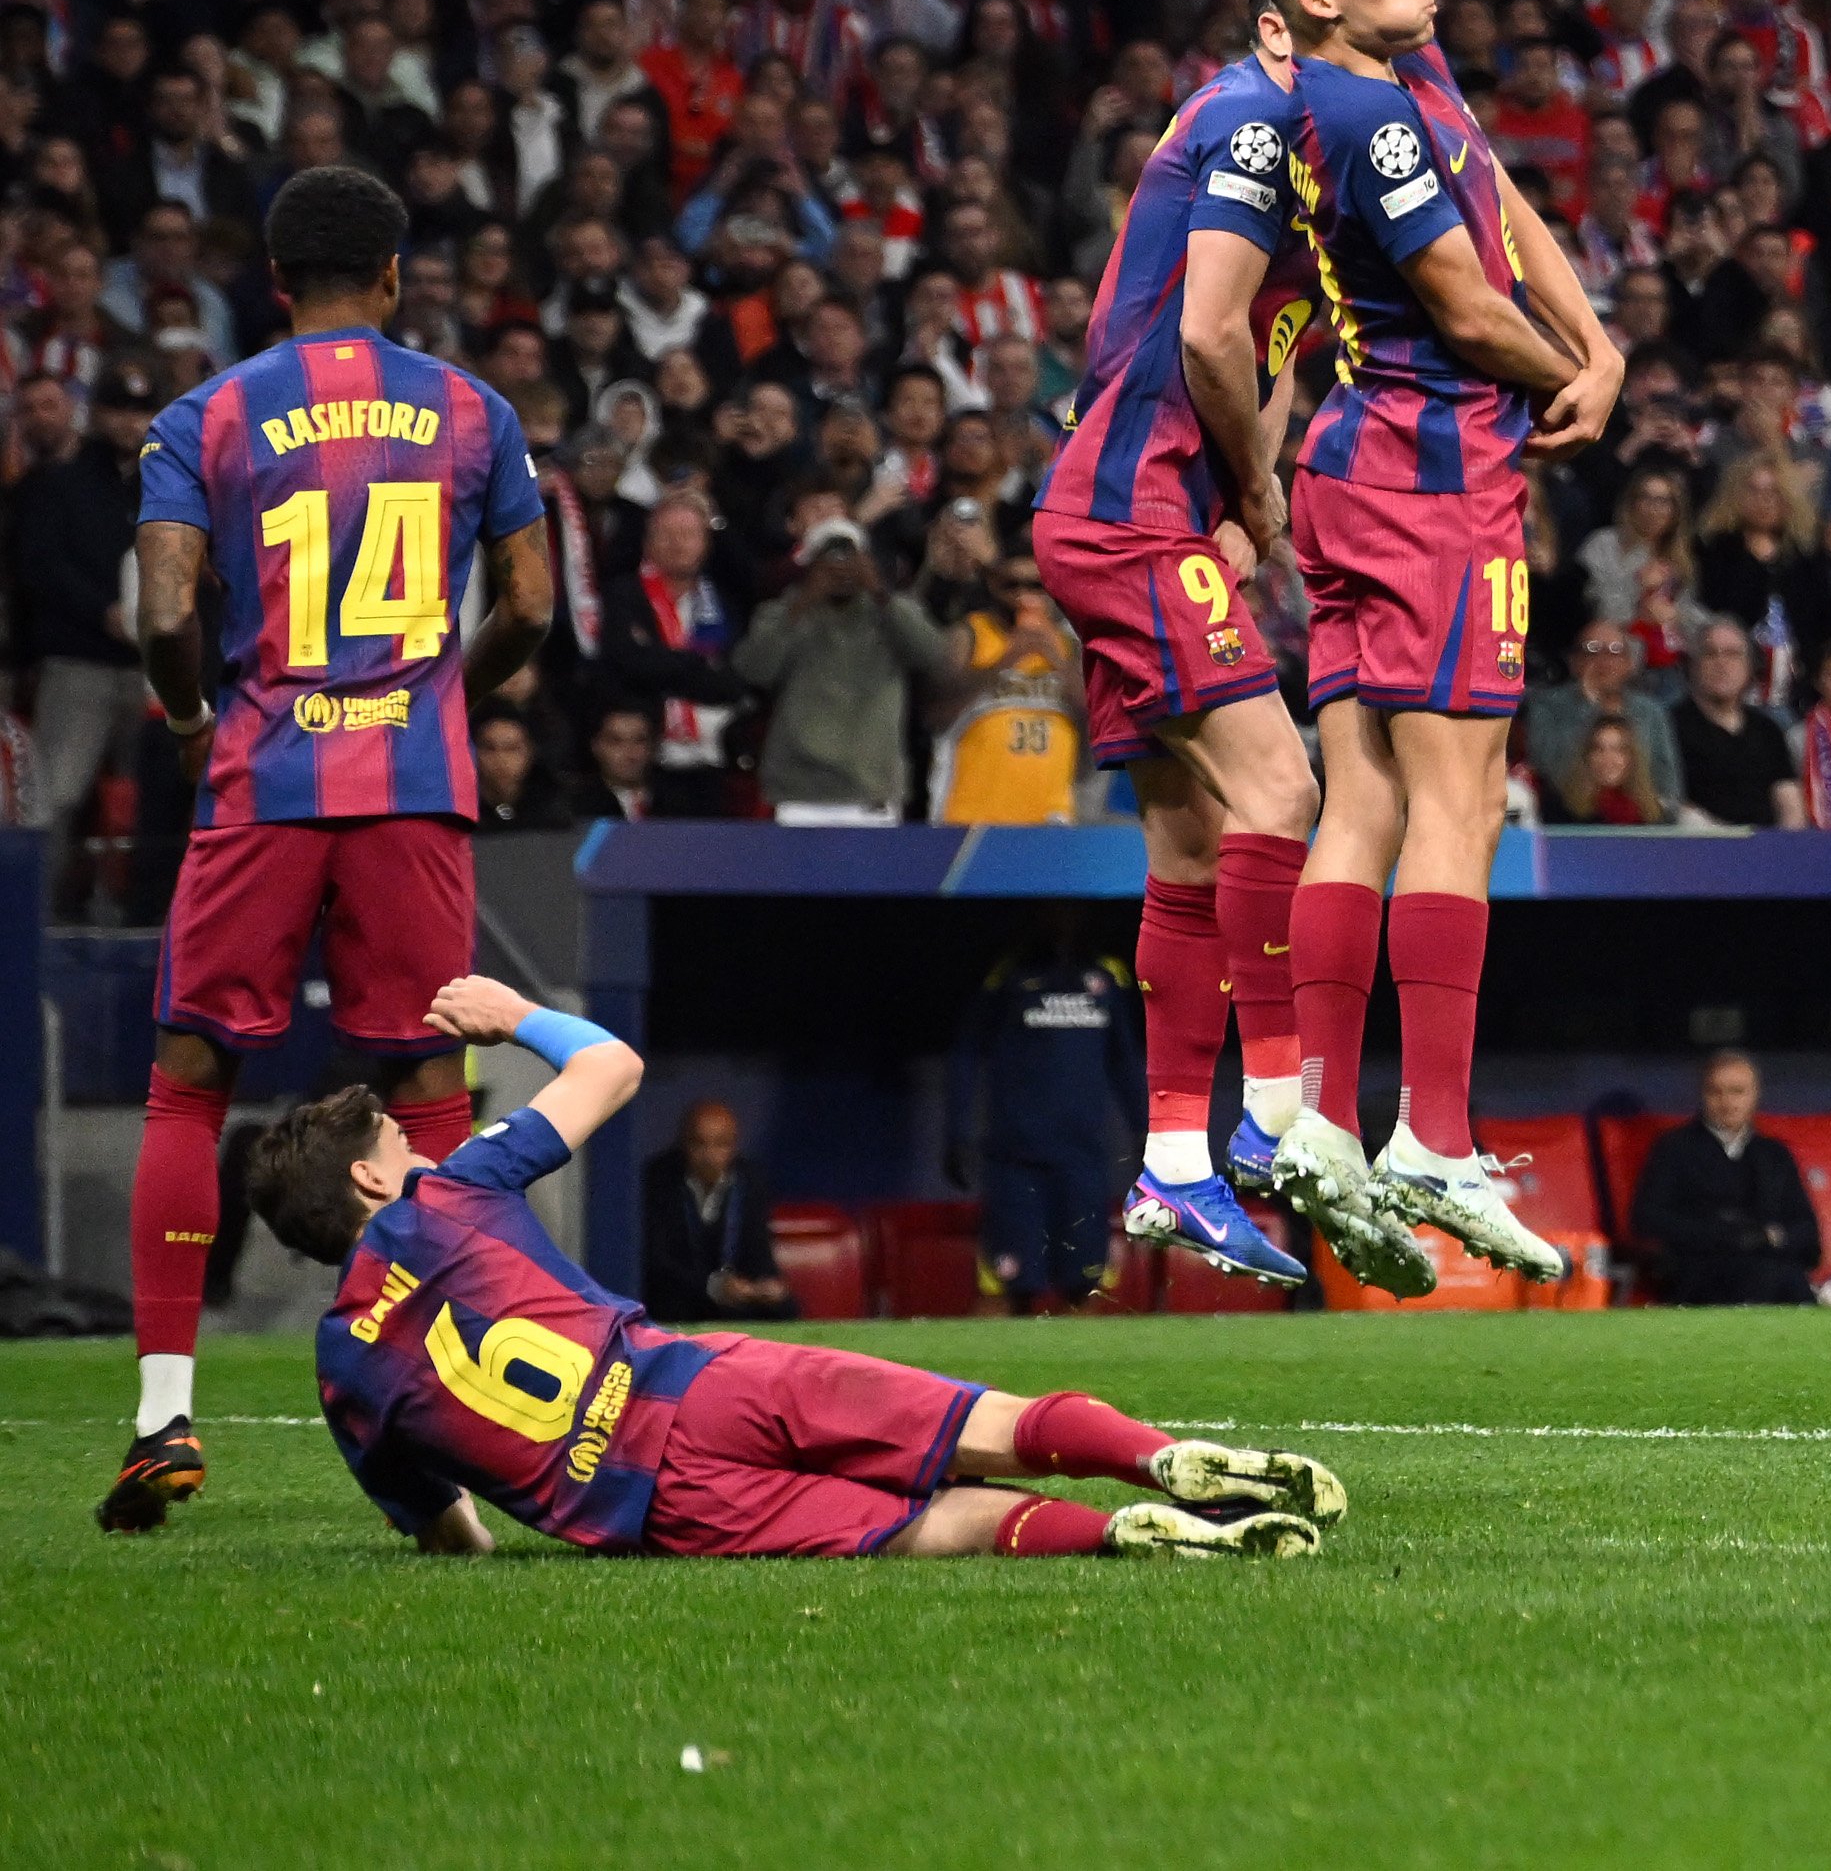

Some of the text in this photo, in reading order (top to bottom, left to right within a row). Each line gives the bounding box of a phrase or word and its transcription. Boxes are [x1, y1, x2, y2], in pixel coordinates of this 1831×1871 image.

[261, 400, 440, 456] RASHFORD
[261, 481, 450, 667] 14
[1177, 554, 1229, 625] 9
[1482, 557, 1530, 637] 18
[342, 689, 410, 713] UNHCR
[342, 702, 408, 726] ACNUR
[350, 1261, 421, 1345] GAVI
[424, 1300, 595, 1443] 6
[582, 1360, 628, 1429] UNHCR
